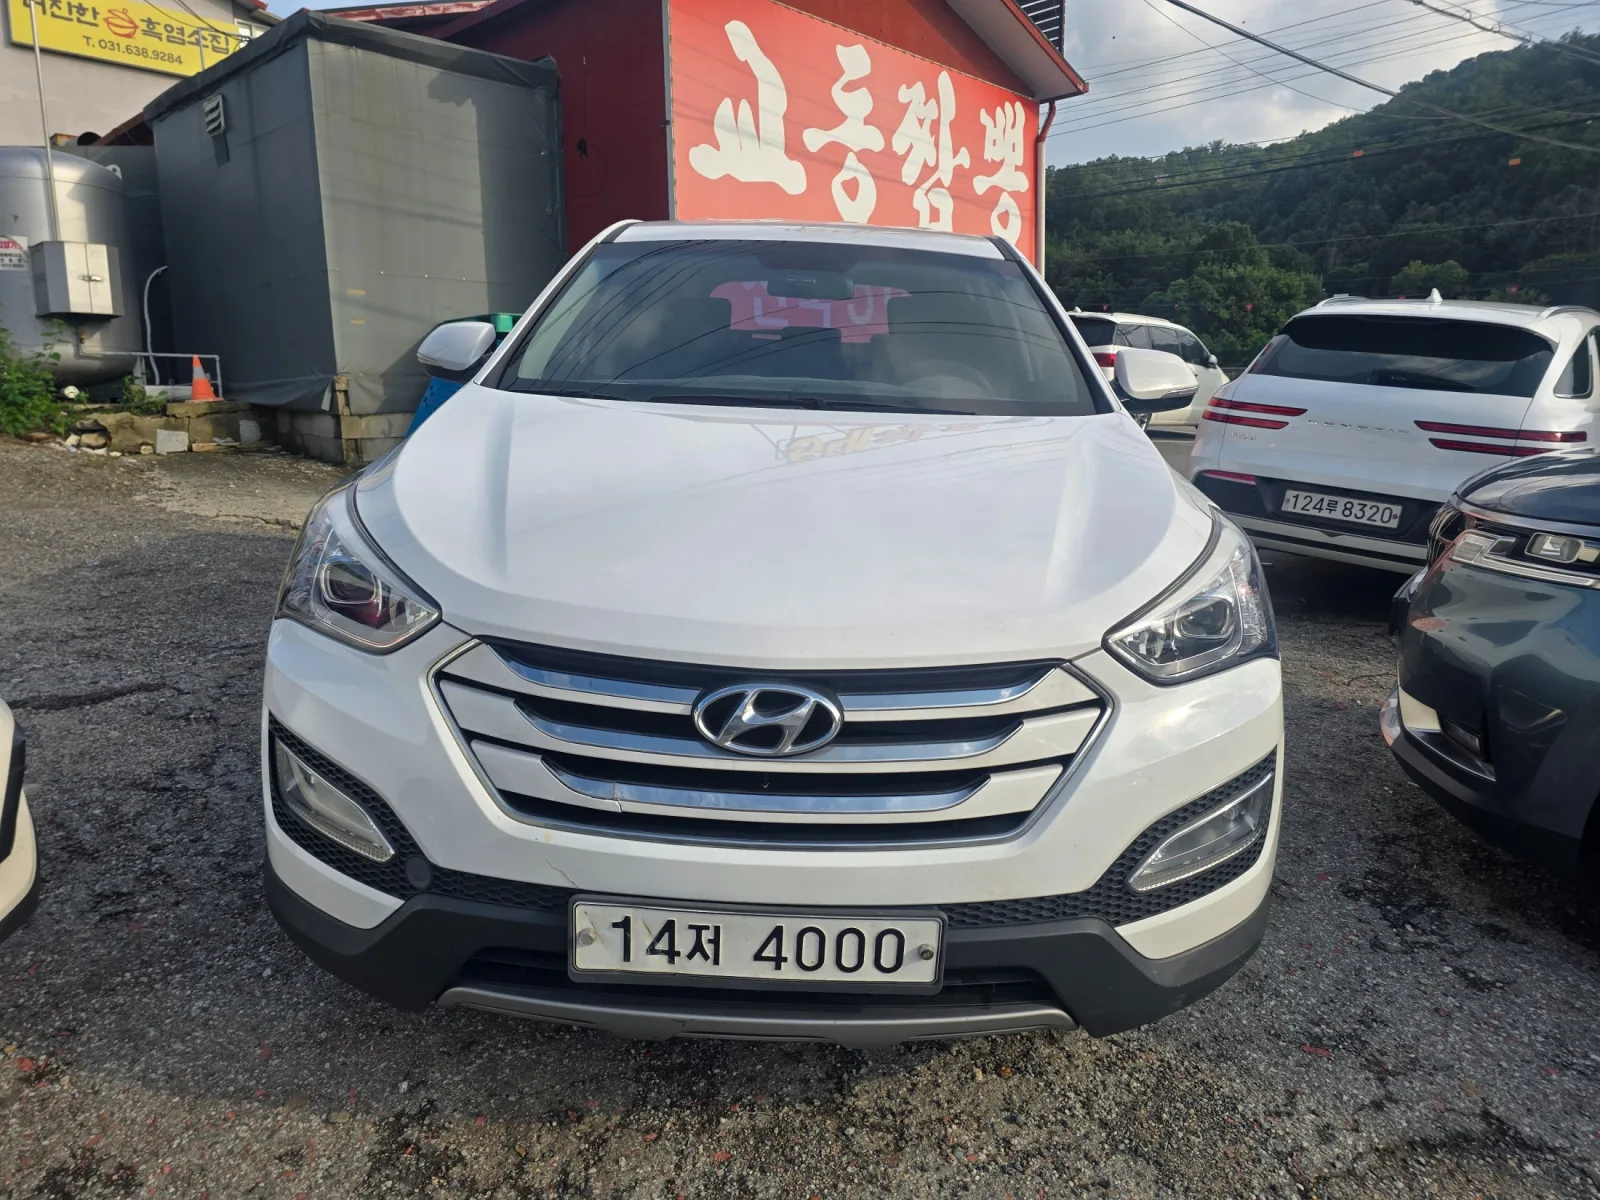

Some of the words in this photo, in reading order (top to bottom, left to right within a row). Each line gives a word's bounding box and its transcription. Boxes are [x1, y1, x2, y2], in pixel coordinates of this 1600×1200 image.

[98, 39, 183, 64] 031.638.9284
[140, 17, 230, 54] 흑염소집
[611, 915, 722, 965] 14저
[753, 925, 905, 974] 4000
